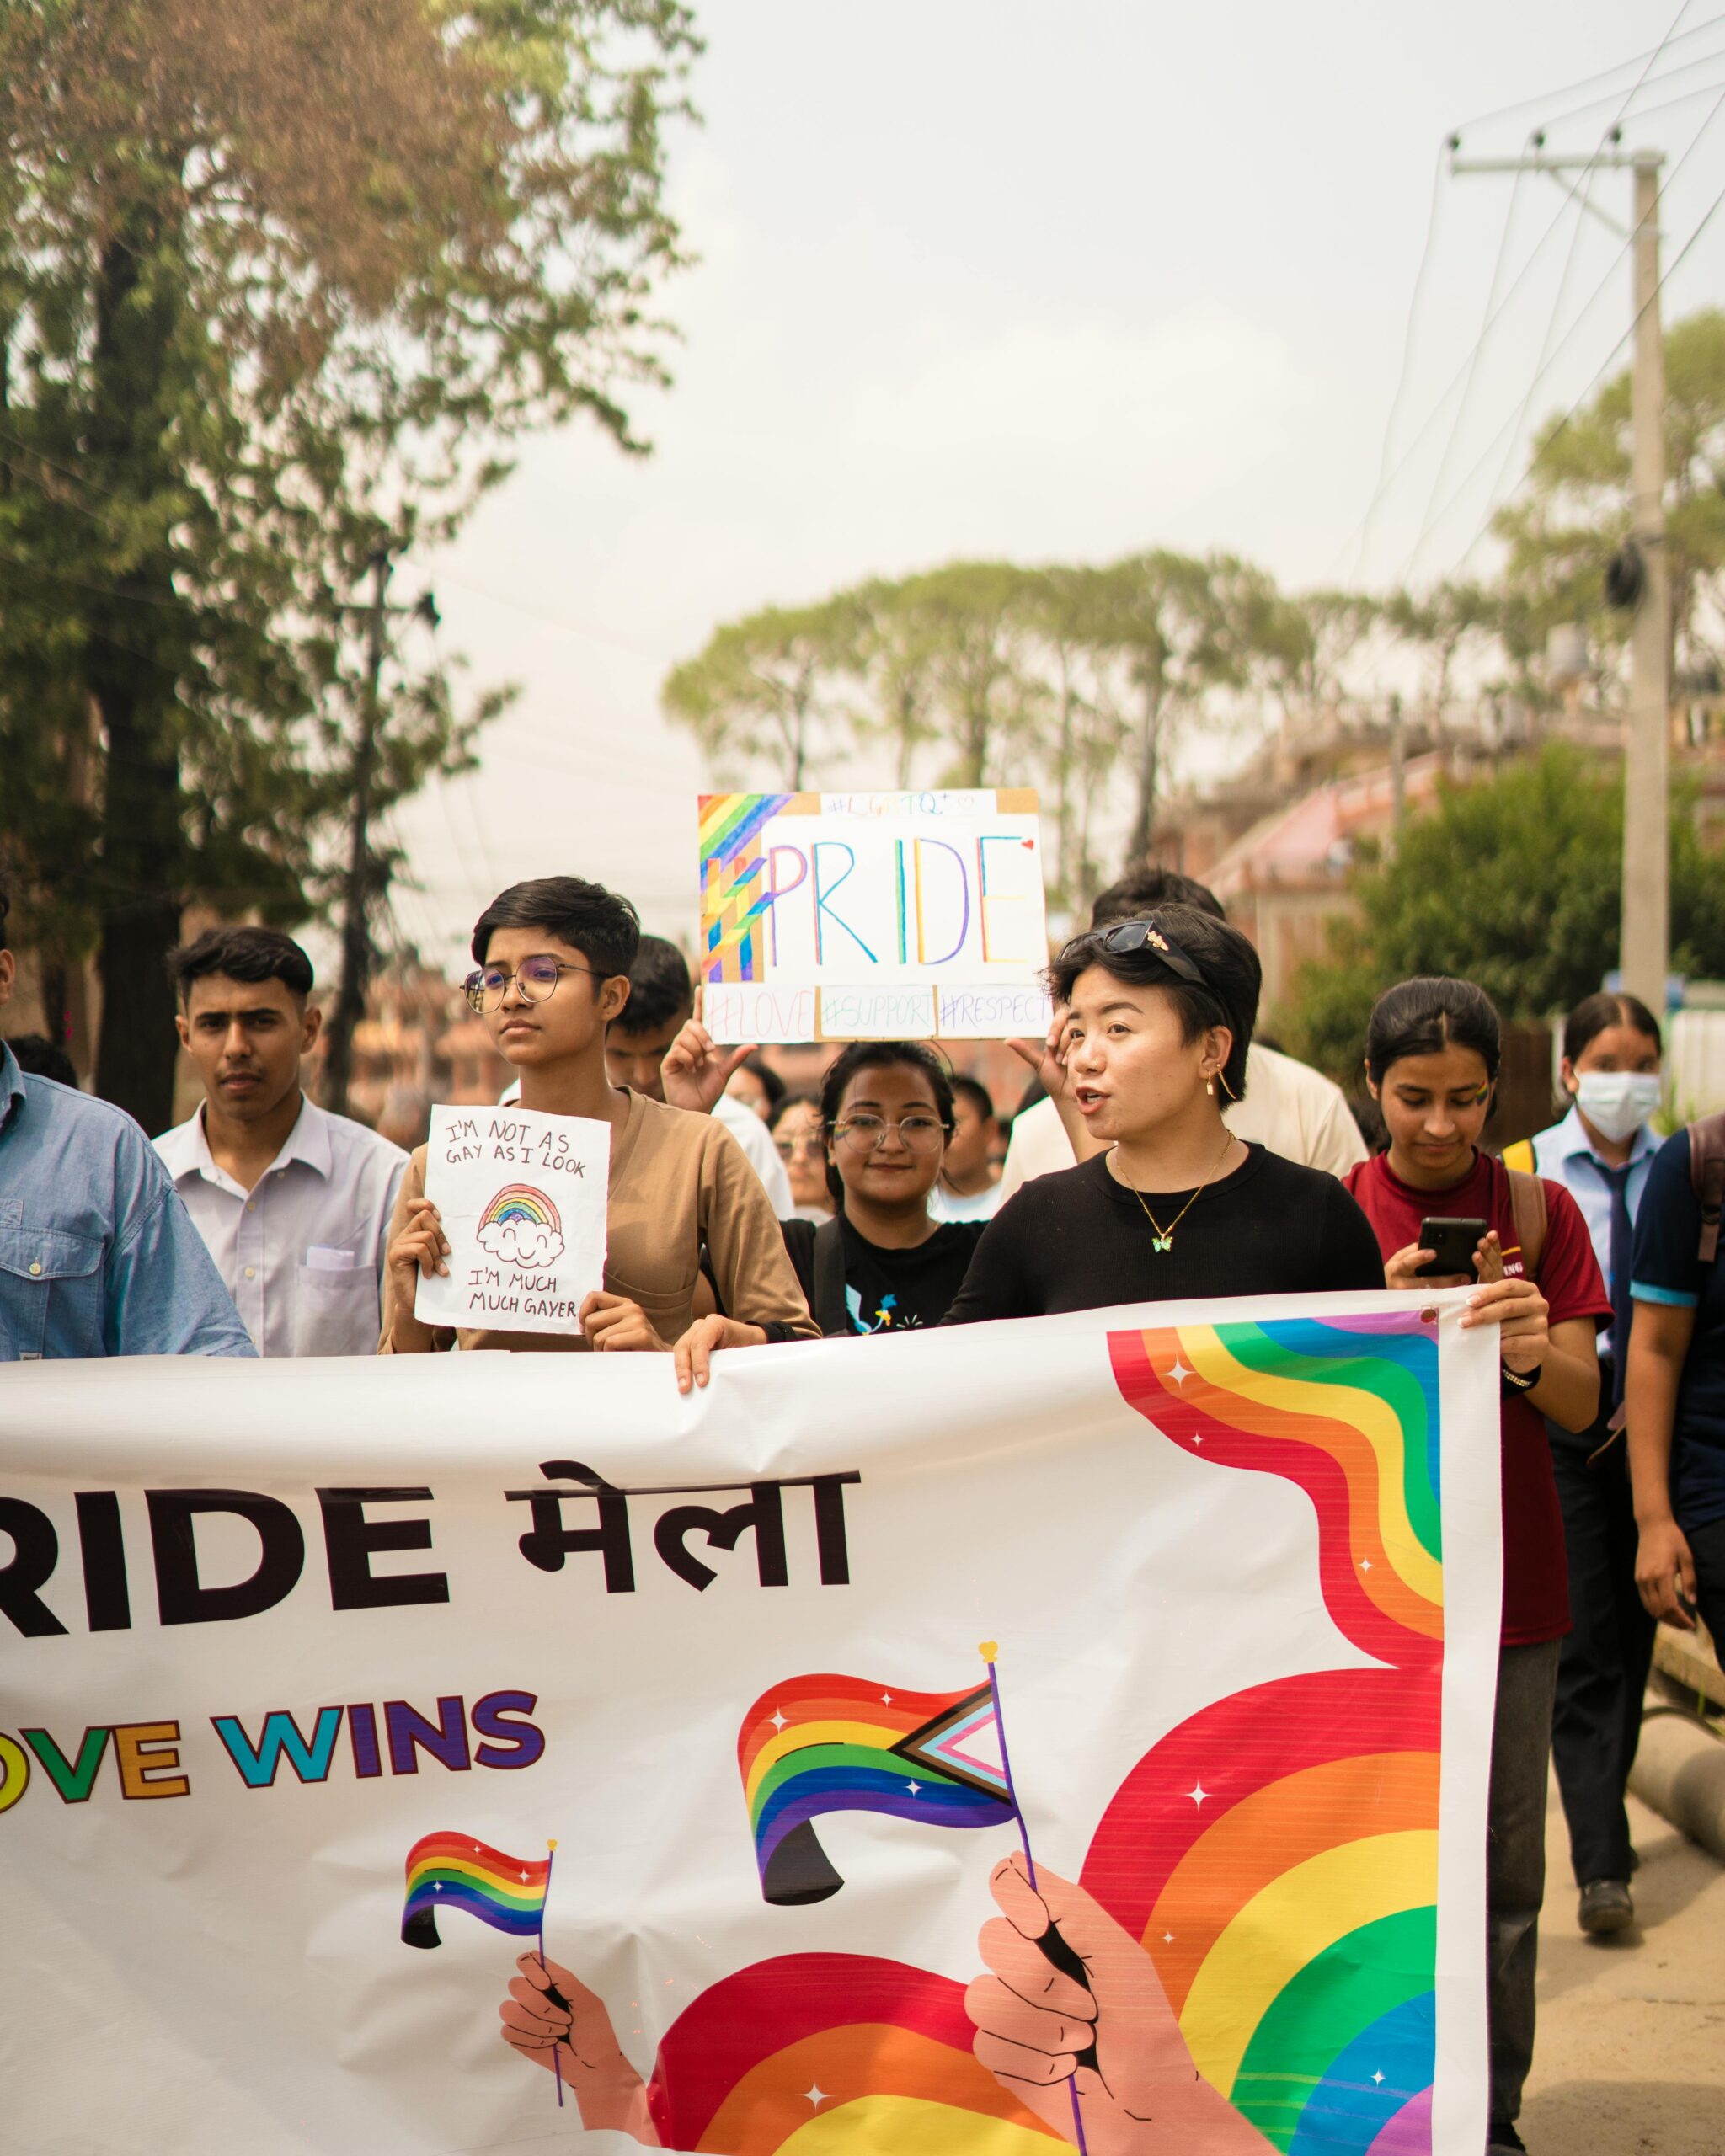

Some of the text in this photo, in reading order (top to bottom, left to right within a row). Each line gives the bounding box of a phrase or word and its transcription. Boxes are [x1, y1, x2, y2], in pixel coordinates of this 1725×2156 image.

[705, 990, 814, 1038] #LOVE
[822, 993, 934, 1028] #SUPPORT
[939, 994, 1051, 1029] #RESPECT
[446, 1120, 569, 1154] I'M NOT AS
[446, 1145, 586, 1178] GAY AS I LOOK
[468, 1267, 557, 1293] I'M MUCH
[469, 1292, 577, 1318] MUCH GAYER
[504, 1460, 861, 1593] मेला
[210, 1689, 546, 1790] WINS
